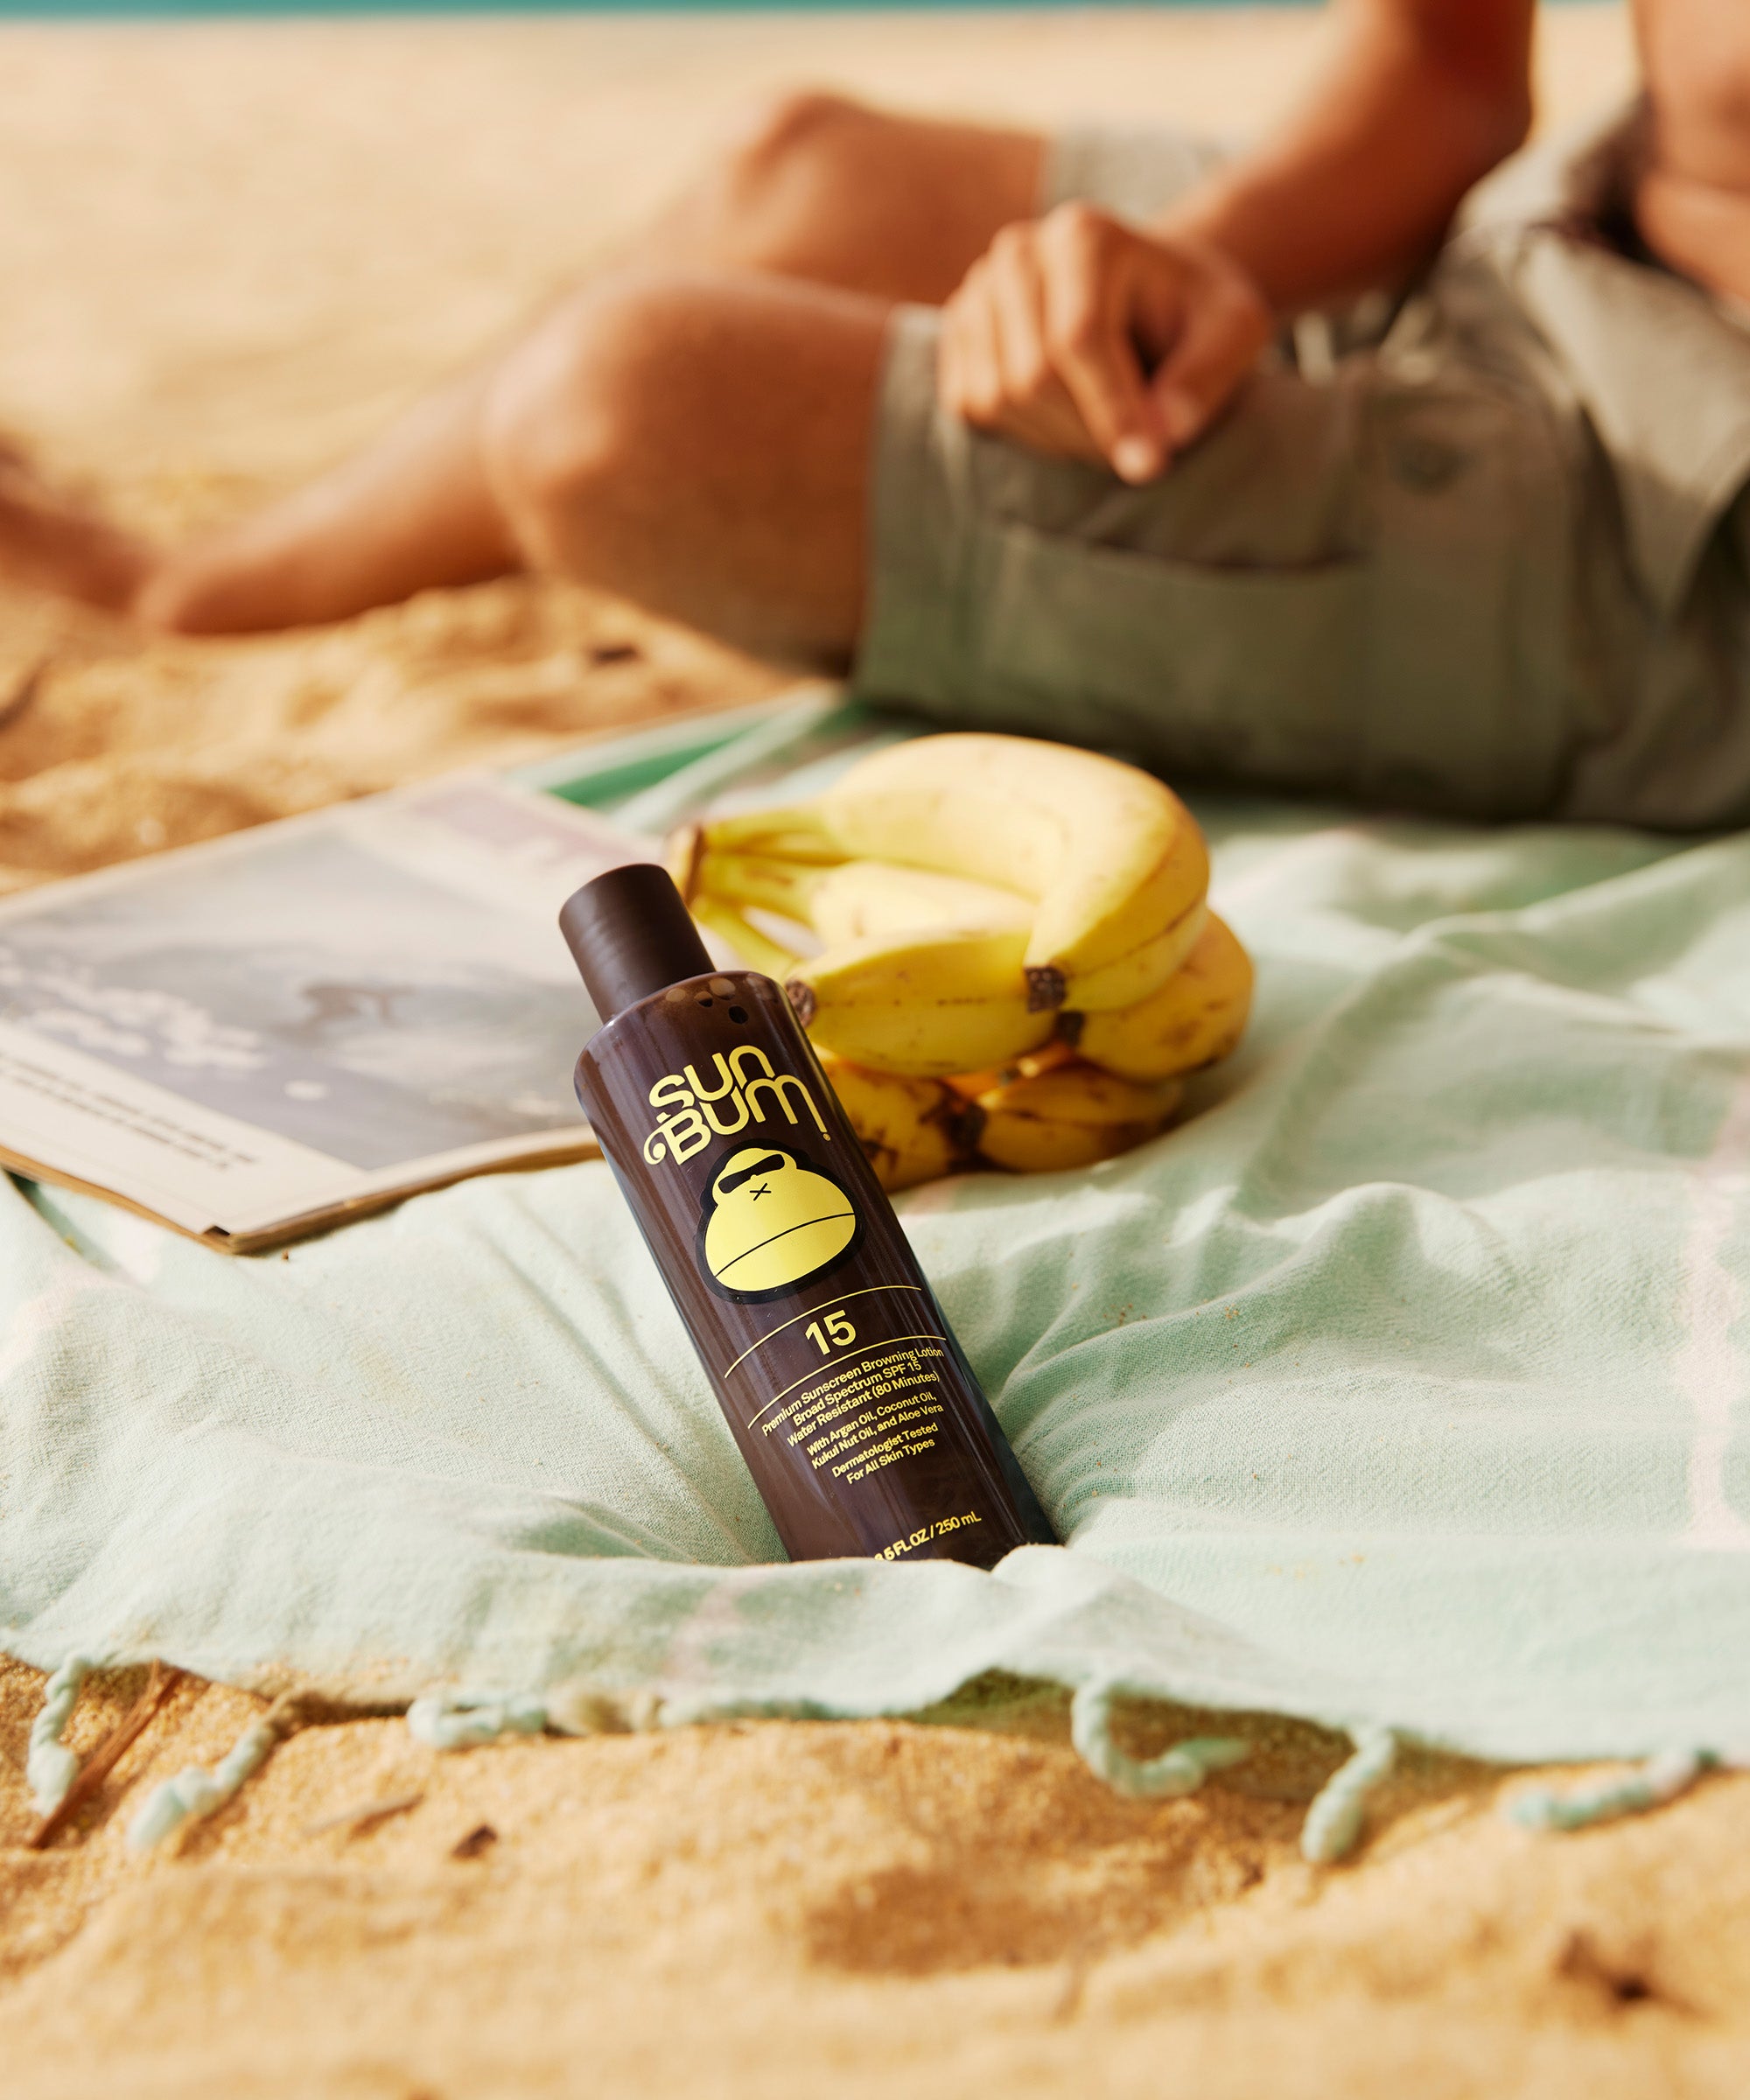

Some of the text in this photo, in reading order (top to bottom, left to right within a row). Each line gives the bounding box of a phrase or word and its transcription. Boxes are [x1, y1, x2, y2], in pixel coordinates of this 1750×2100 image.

[805, 1309, 857, 1356] 15
[761, 1347, 944, 1437] Premium Sunscreen Browning Lotion
[787, 1370, 940, 1447] Water Resistant (80 Minutes)
[792, 1361, 922, 1426] Broad Spectrum SPF 15
[807, 1391, 937, 1456] With Argan Oil, Coconut Oil,
[811, 1404, 944, 1470] Kukui Nut Oil, and Aloe Vera
[831, 1422, 939, 1478] Dermatologist Tested
[846, 1438, 935, 1485] For All Skin Types
[935, 1516, 961, 1536] 250
[961, 1511, 982, 1526] mL
